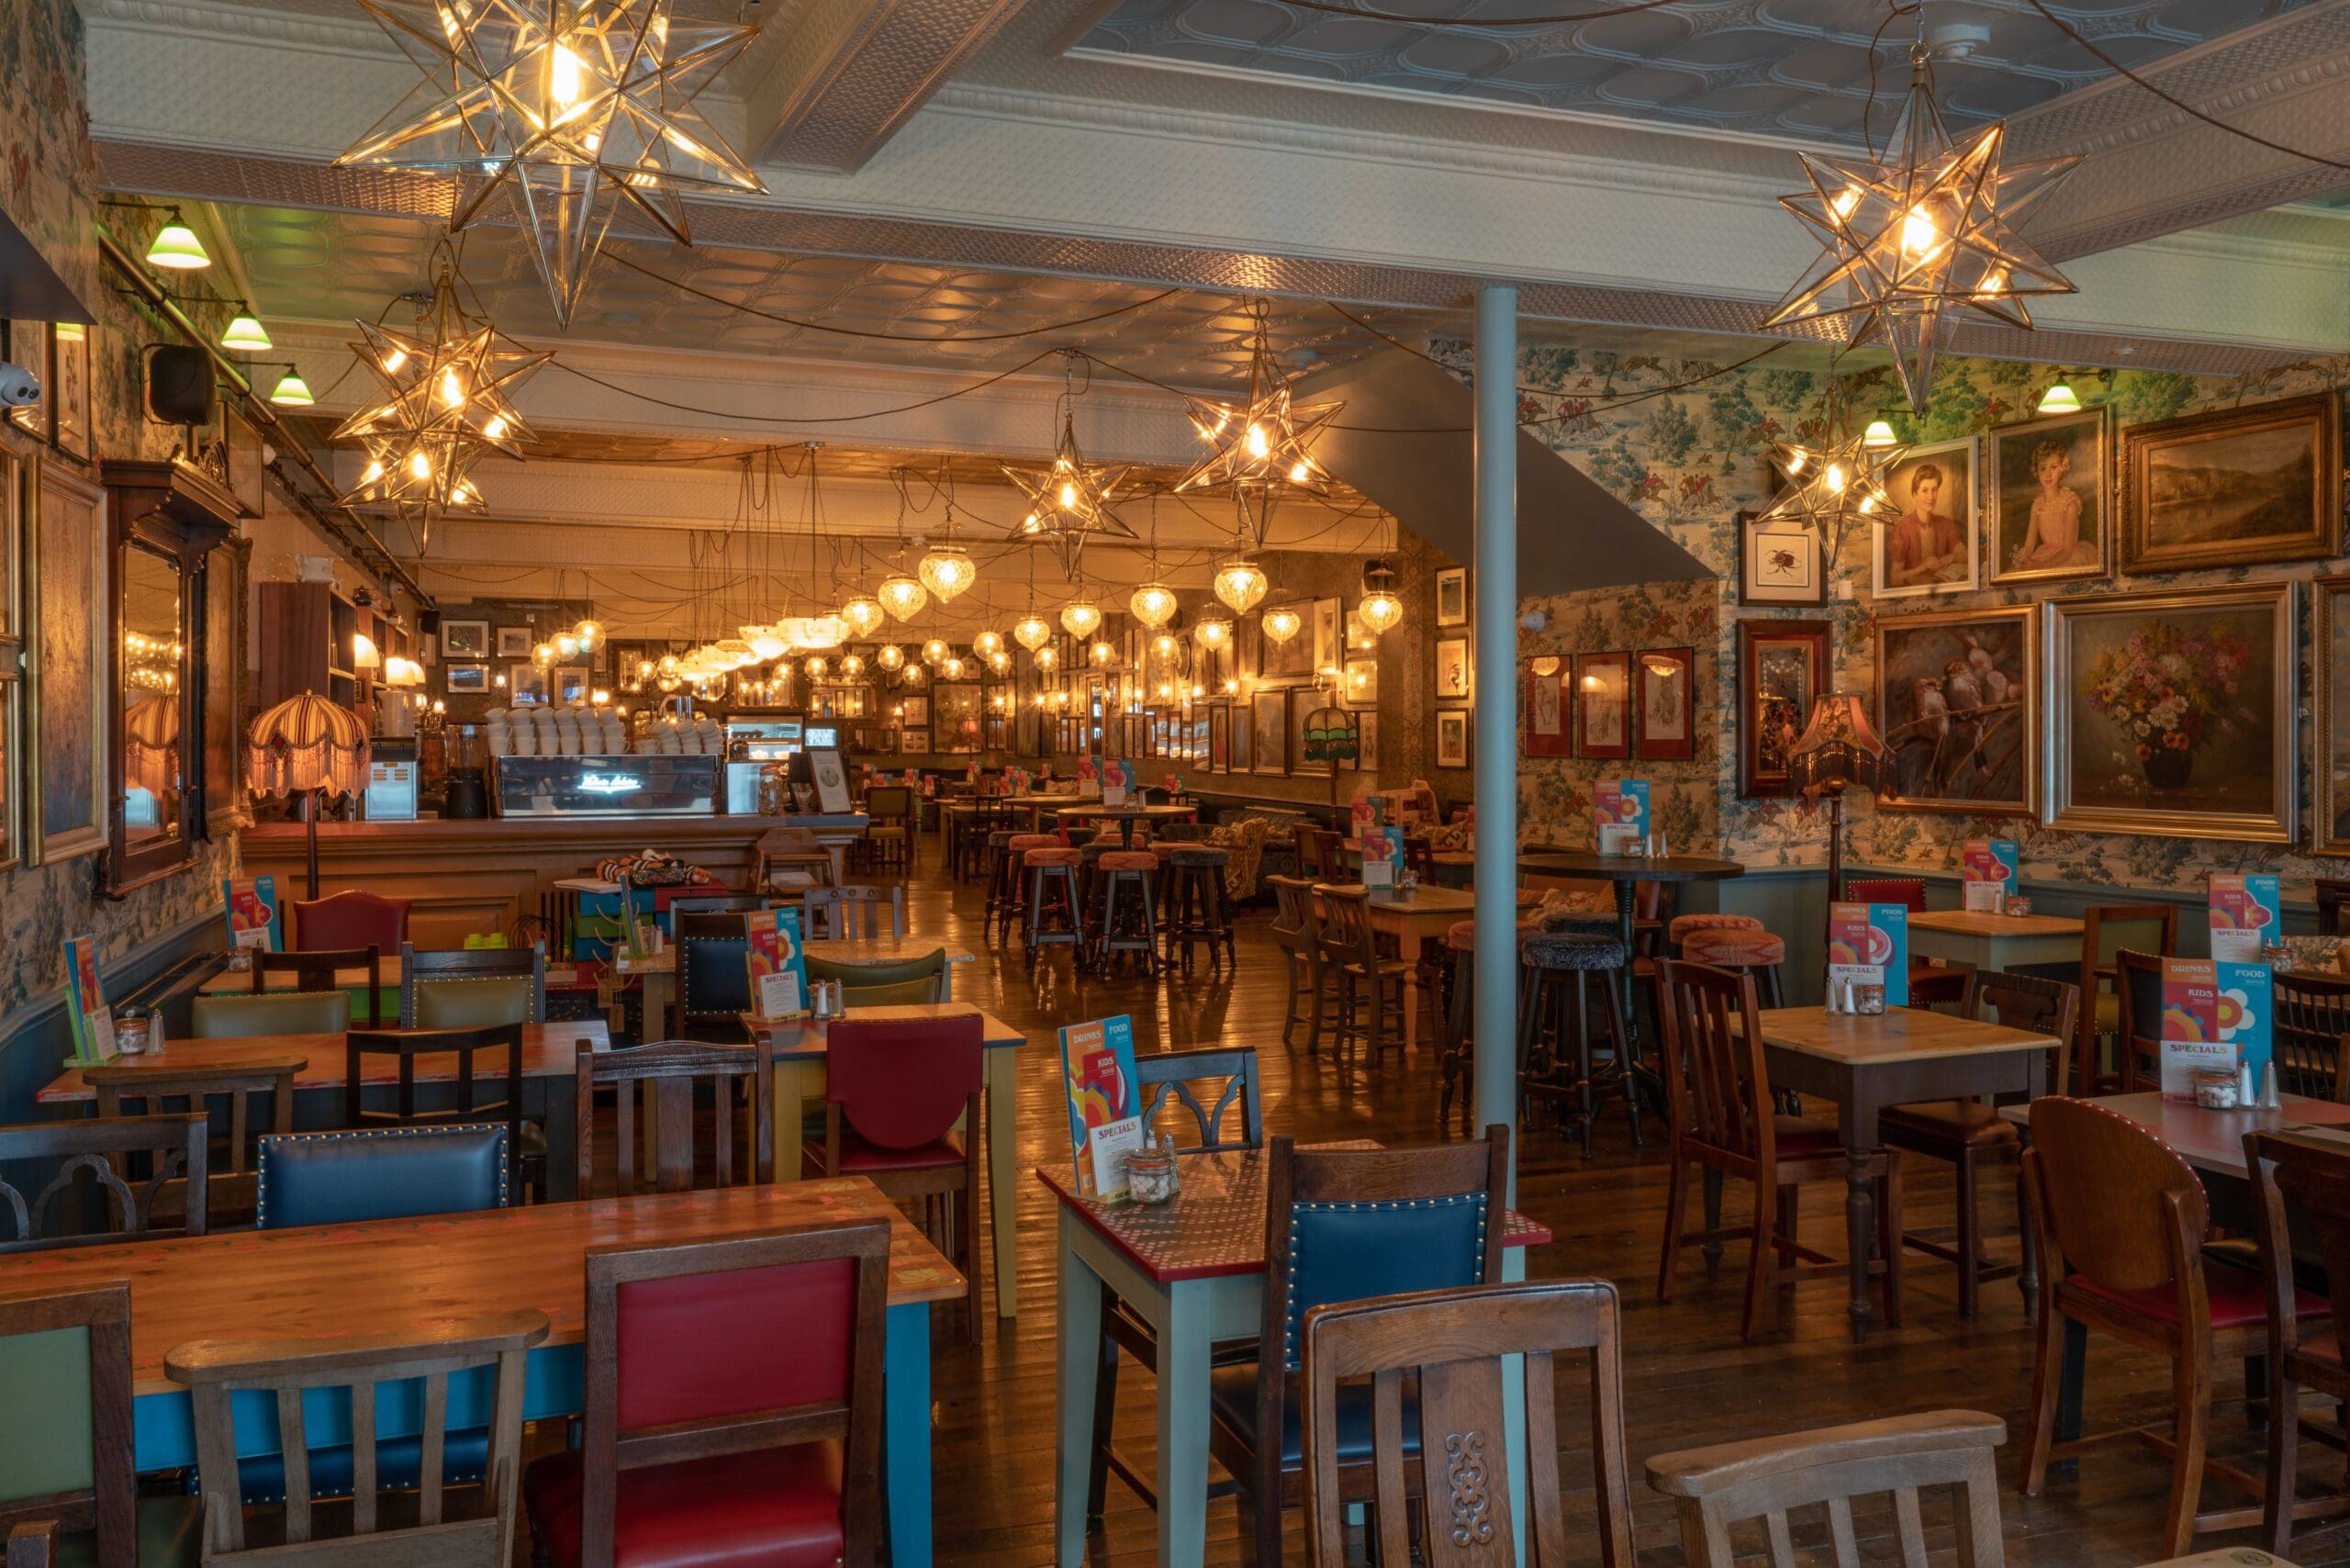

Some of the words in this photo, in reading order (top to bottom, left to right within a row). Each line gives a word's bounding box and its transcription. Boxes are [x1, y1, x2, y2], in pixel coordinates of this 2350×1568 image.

[2170, 964, 2211, 973] DRINKS
[2235, 969, 2266, 978] FOOD
[765, 973, 794, 984] SPECIALS
[2188, 989, 2213, 998] KIDS
[1109, 1023, 1128, 1036] FOOD
[1073, 1030, 1102, 1044] DRINKS
[2169, 1044, 2227, 1055] SPECIALS
[1097, 1056, 1114, 1069] KIDS
[1098, 1121, 1136, 1140] SPECIALS
